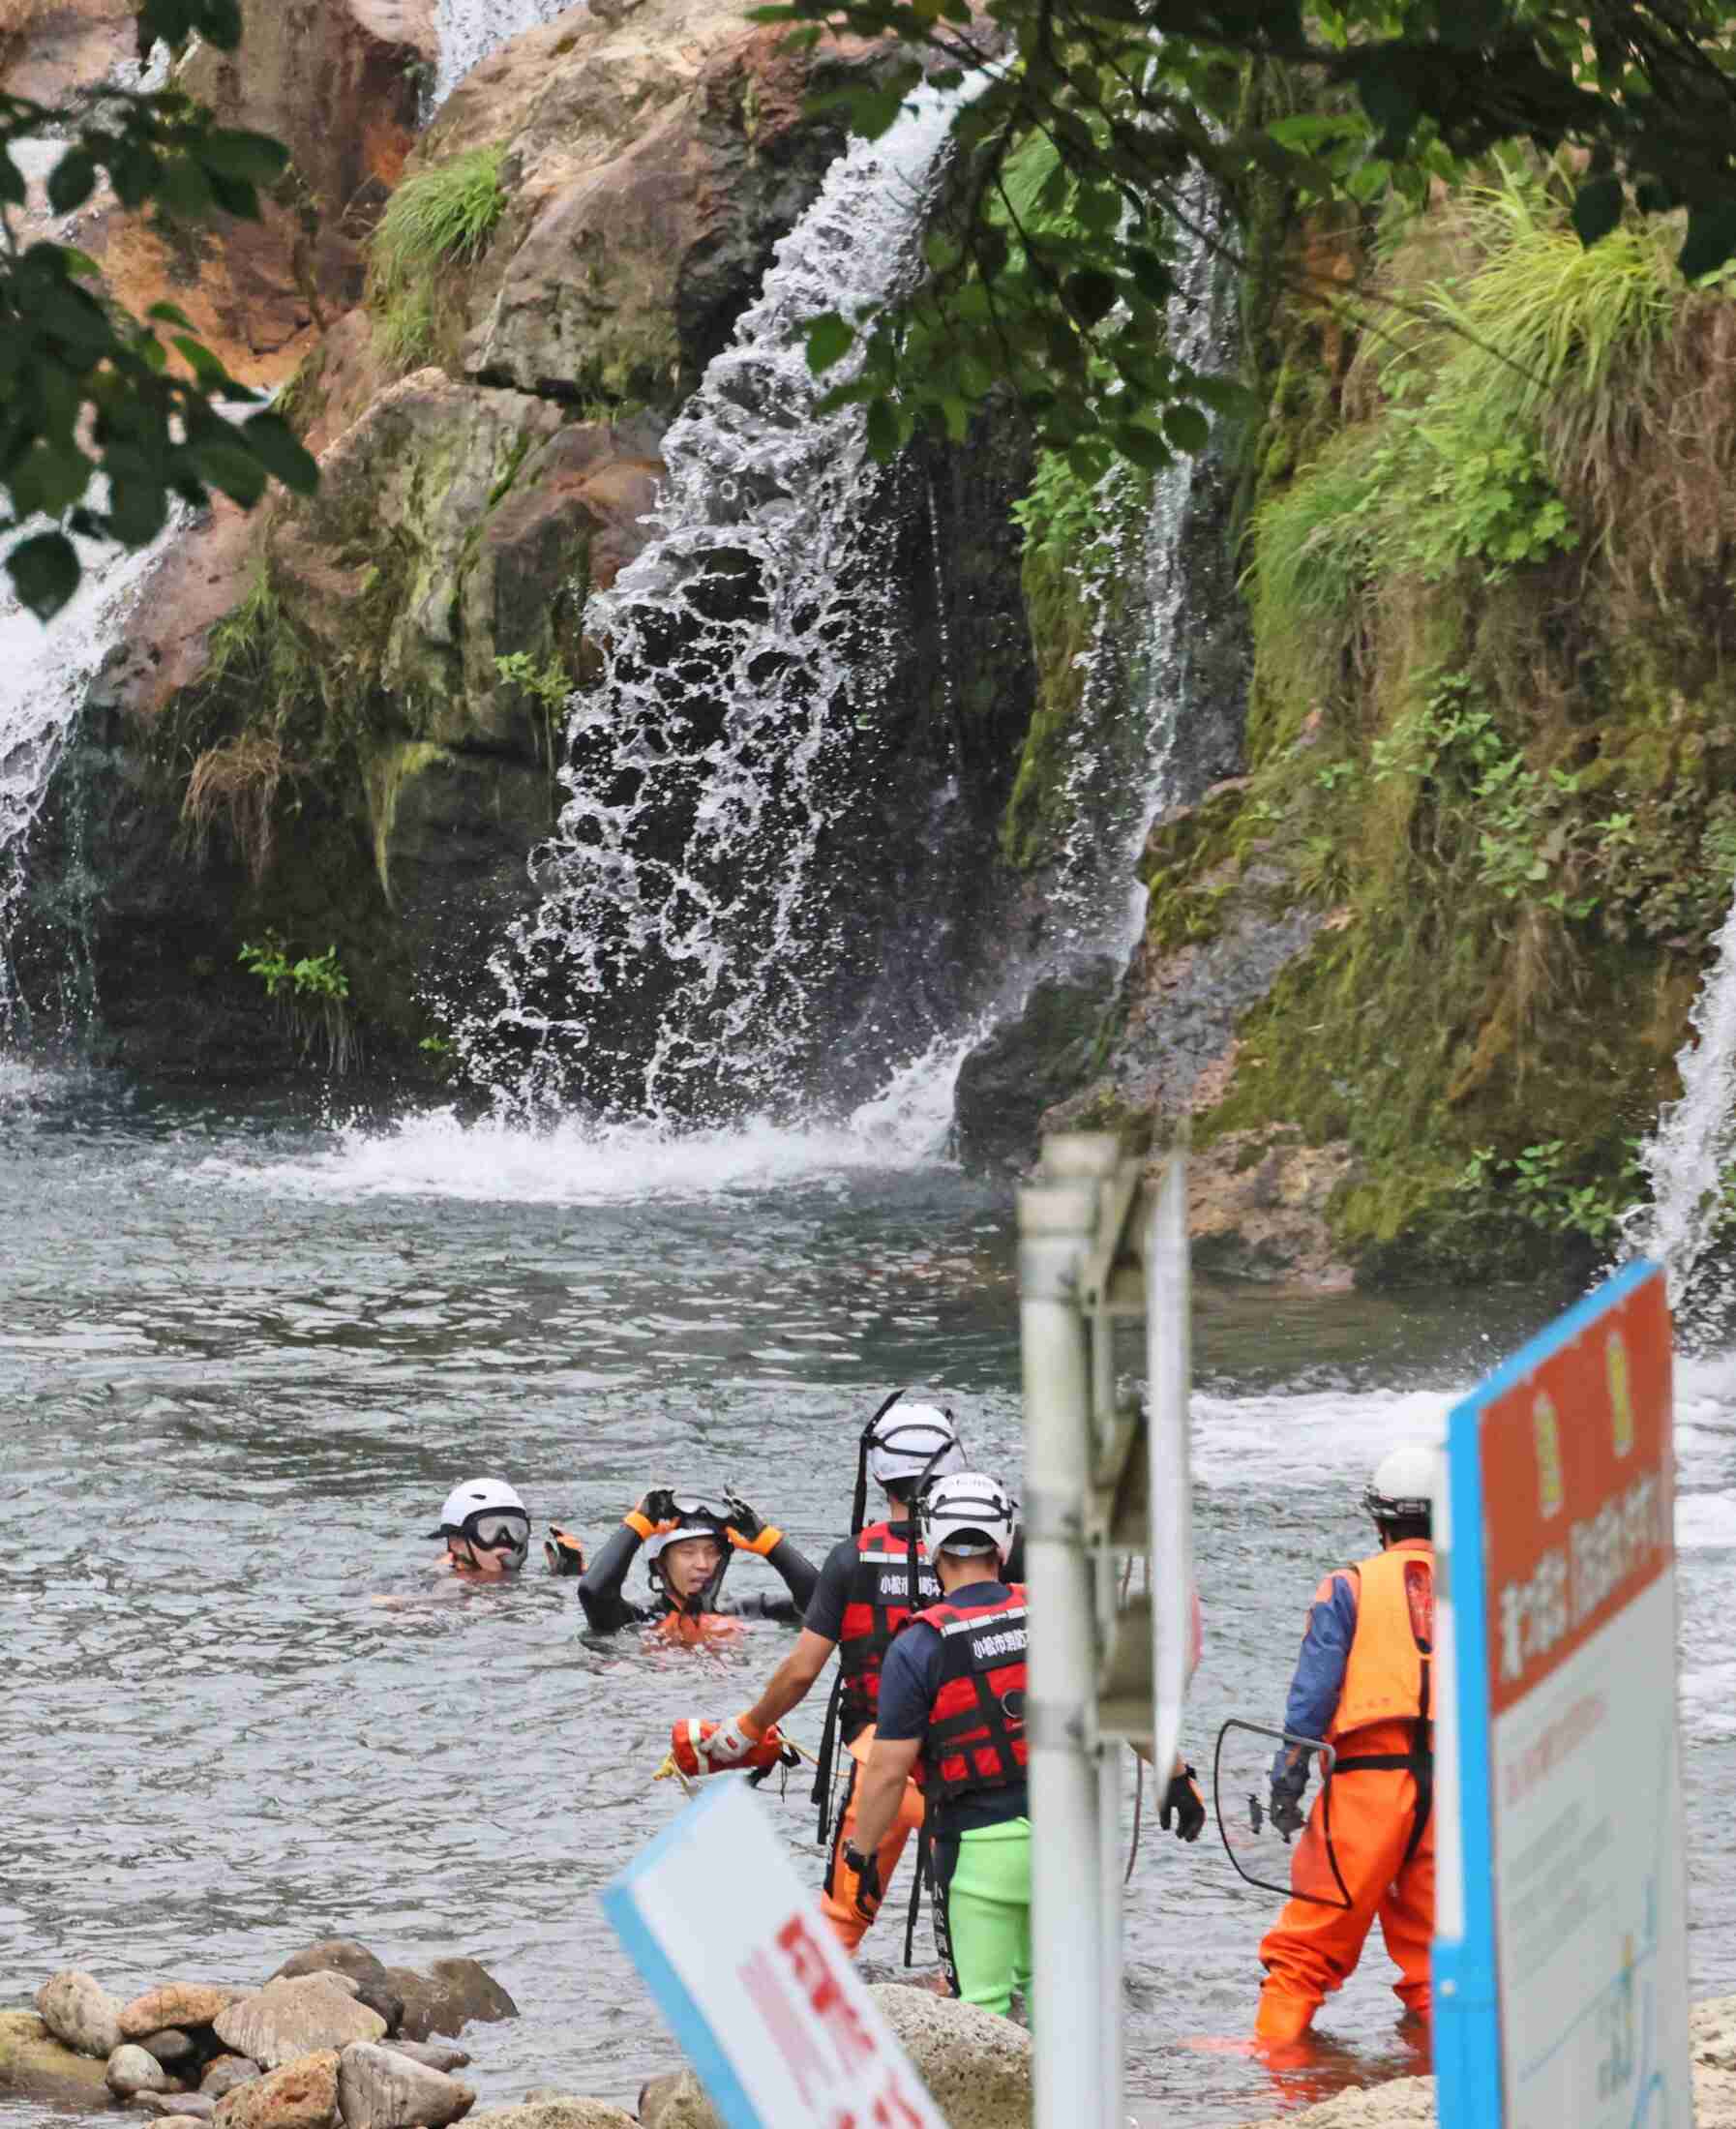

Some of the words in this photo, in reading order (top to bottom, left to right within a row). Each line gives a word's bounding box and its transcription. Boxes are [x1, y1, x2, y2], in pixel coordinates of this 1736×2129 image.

[880, 1574, 942, 1597] 小松市防本
